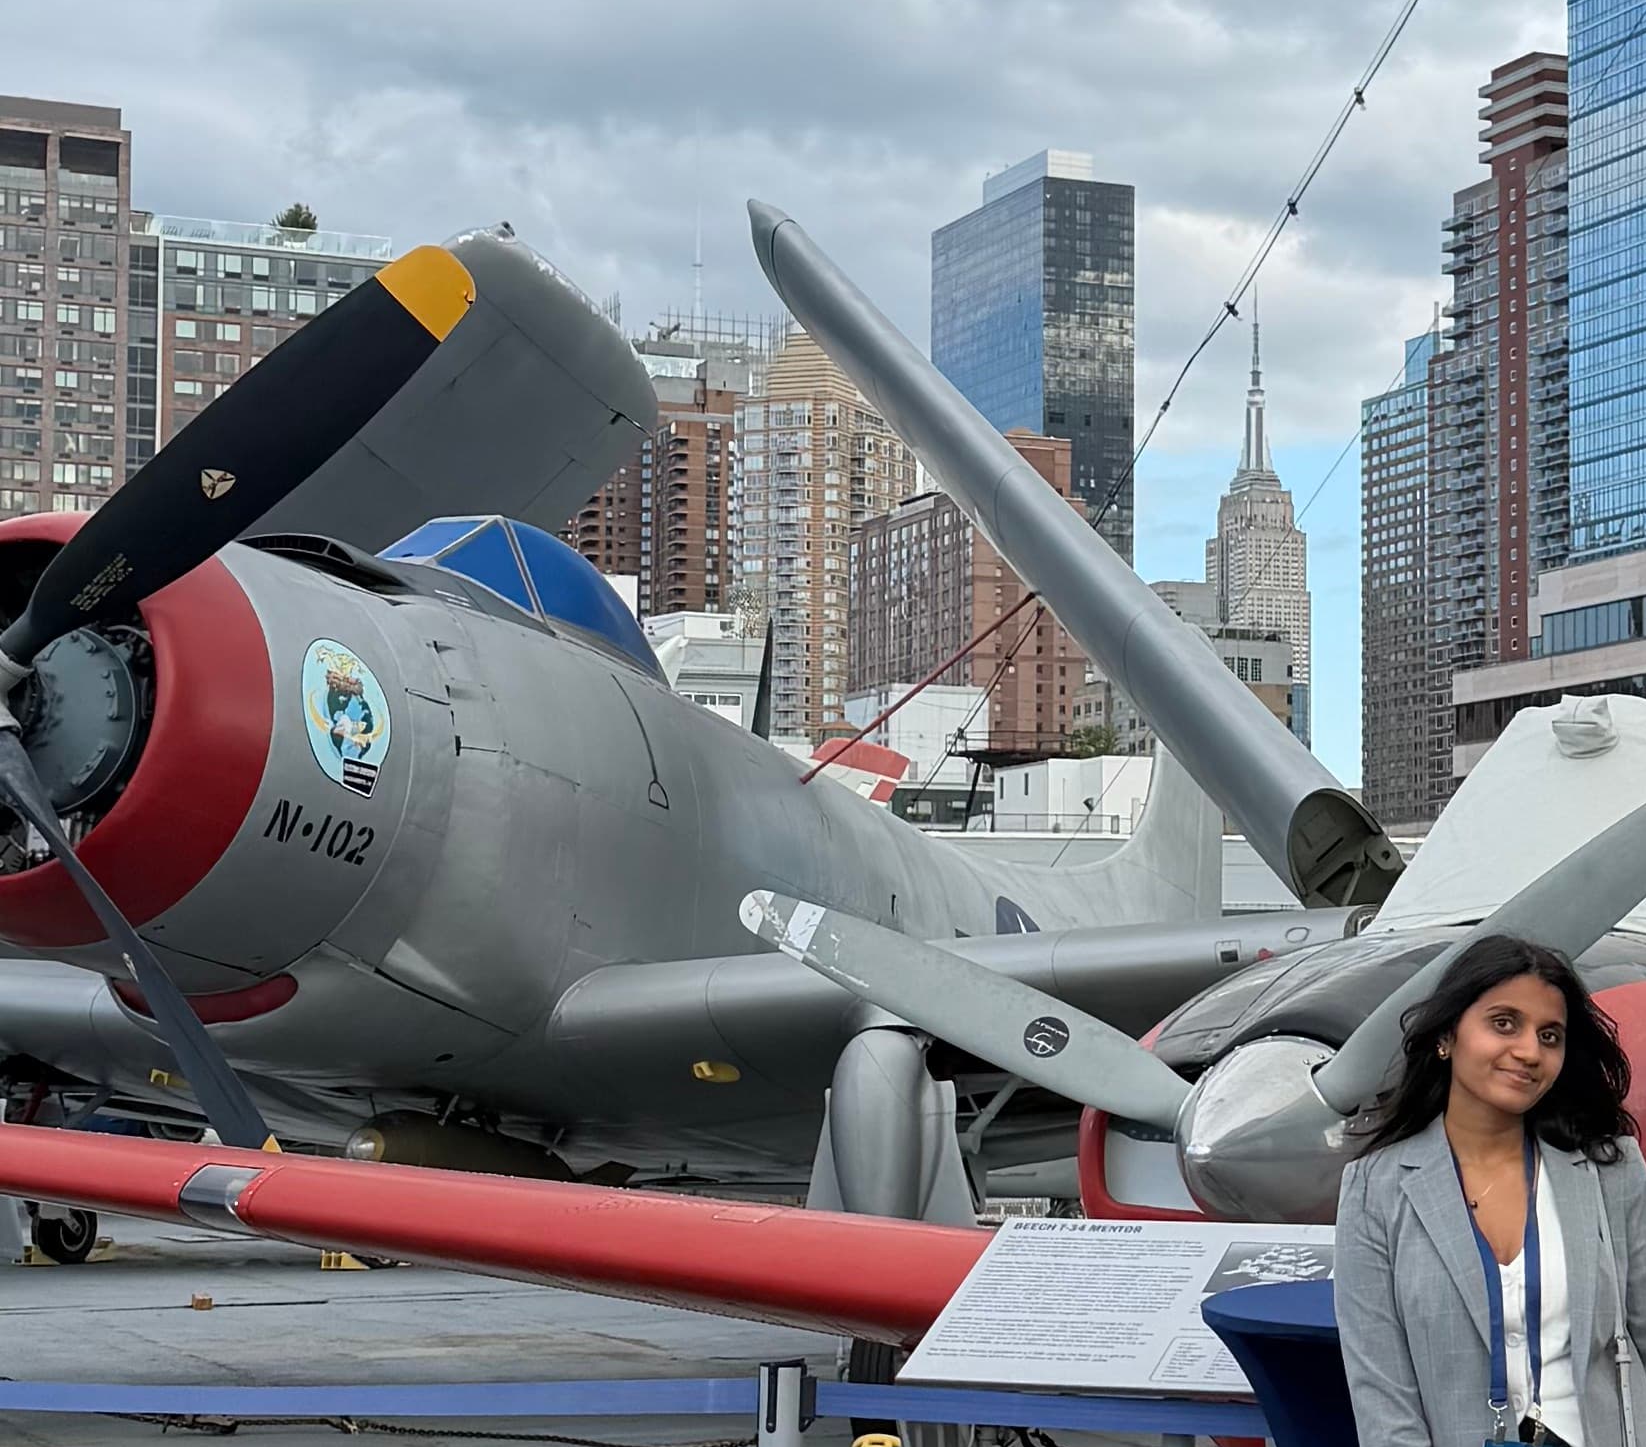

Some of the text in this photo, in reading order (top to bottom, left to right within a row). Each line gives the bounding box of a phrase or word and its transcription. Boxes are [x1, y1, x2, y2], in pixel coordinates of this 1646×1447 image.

[1013, 1222, 1143, 1235] BEECH T-34 MENTOR
